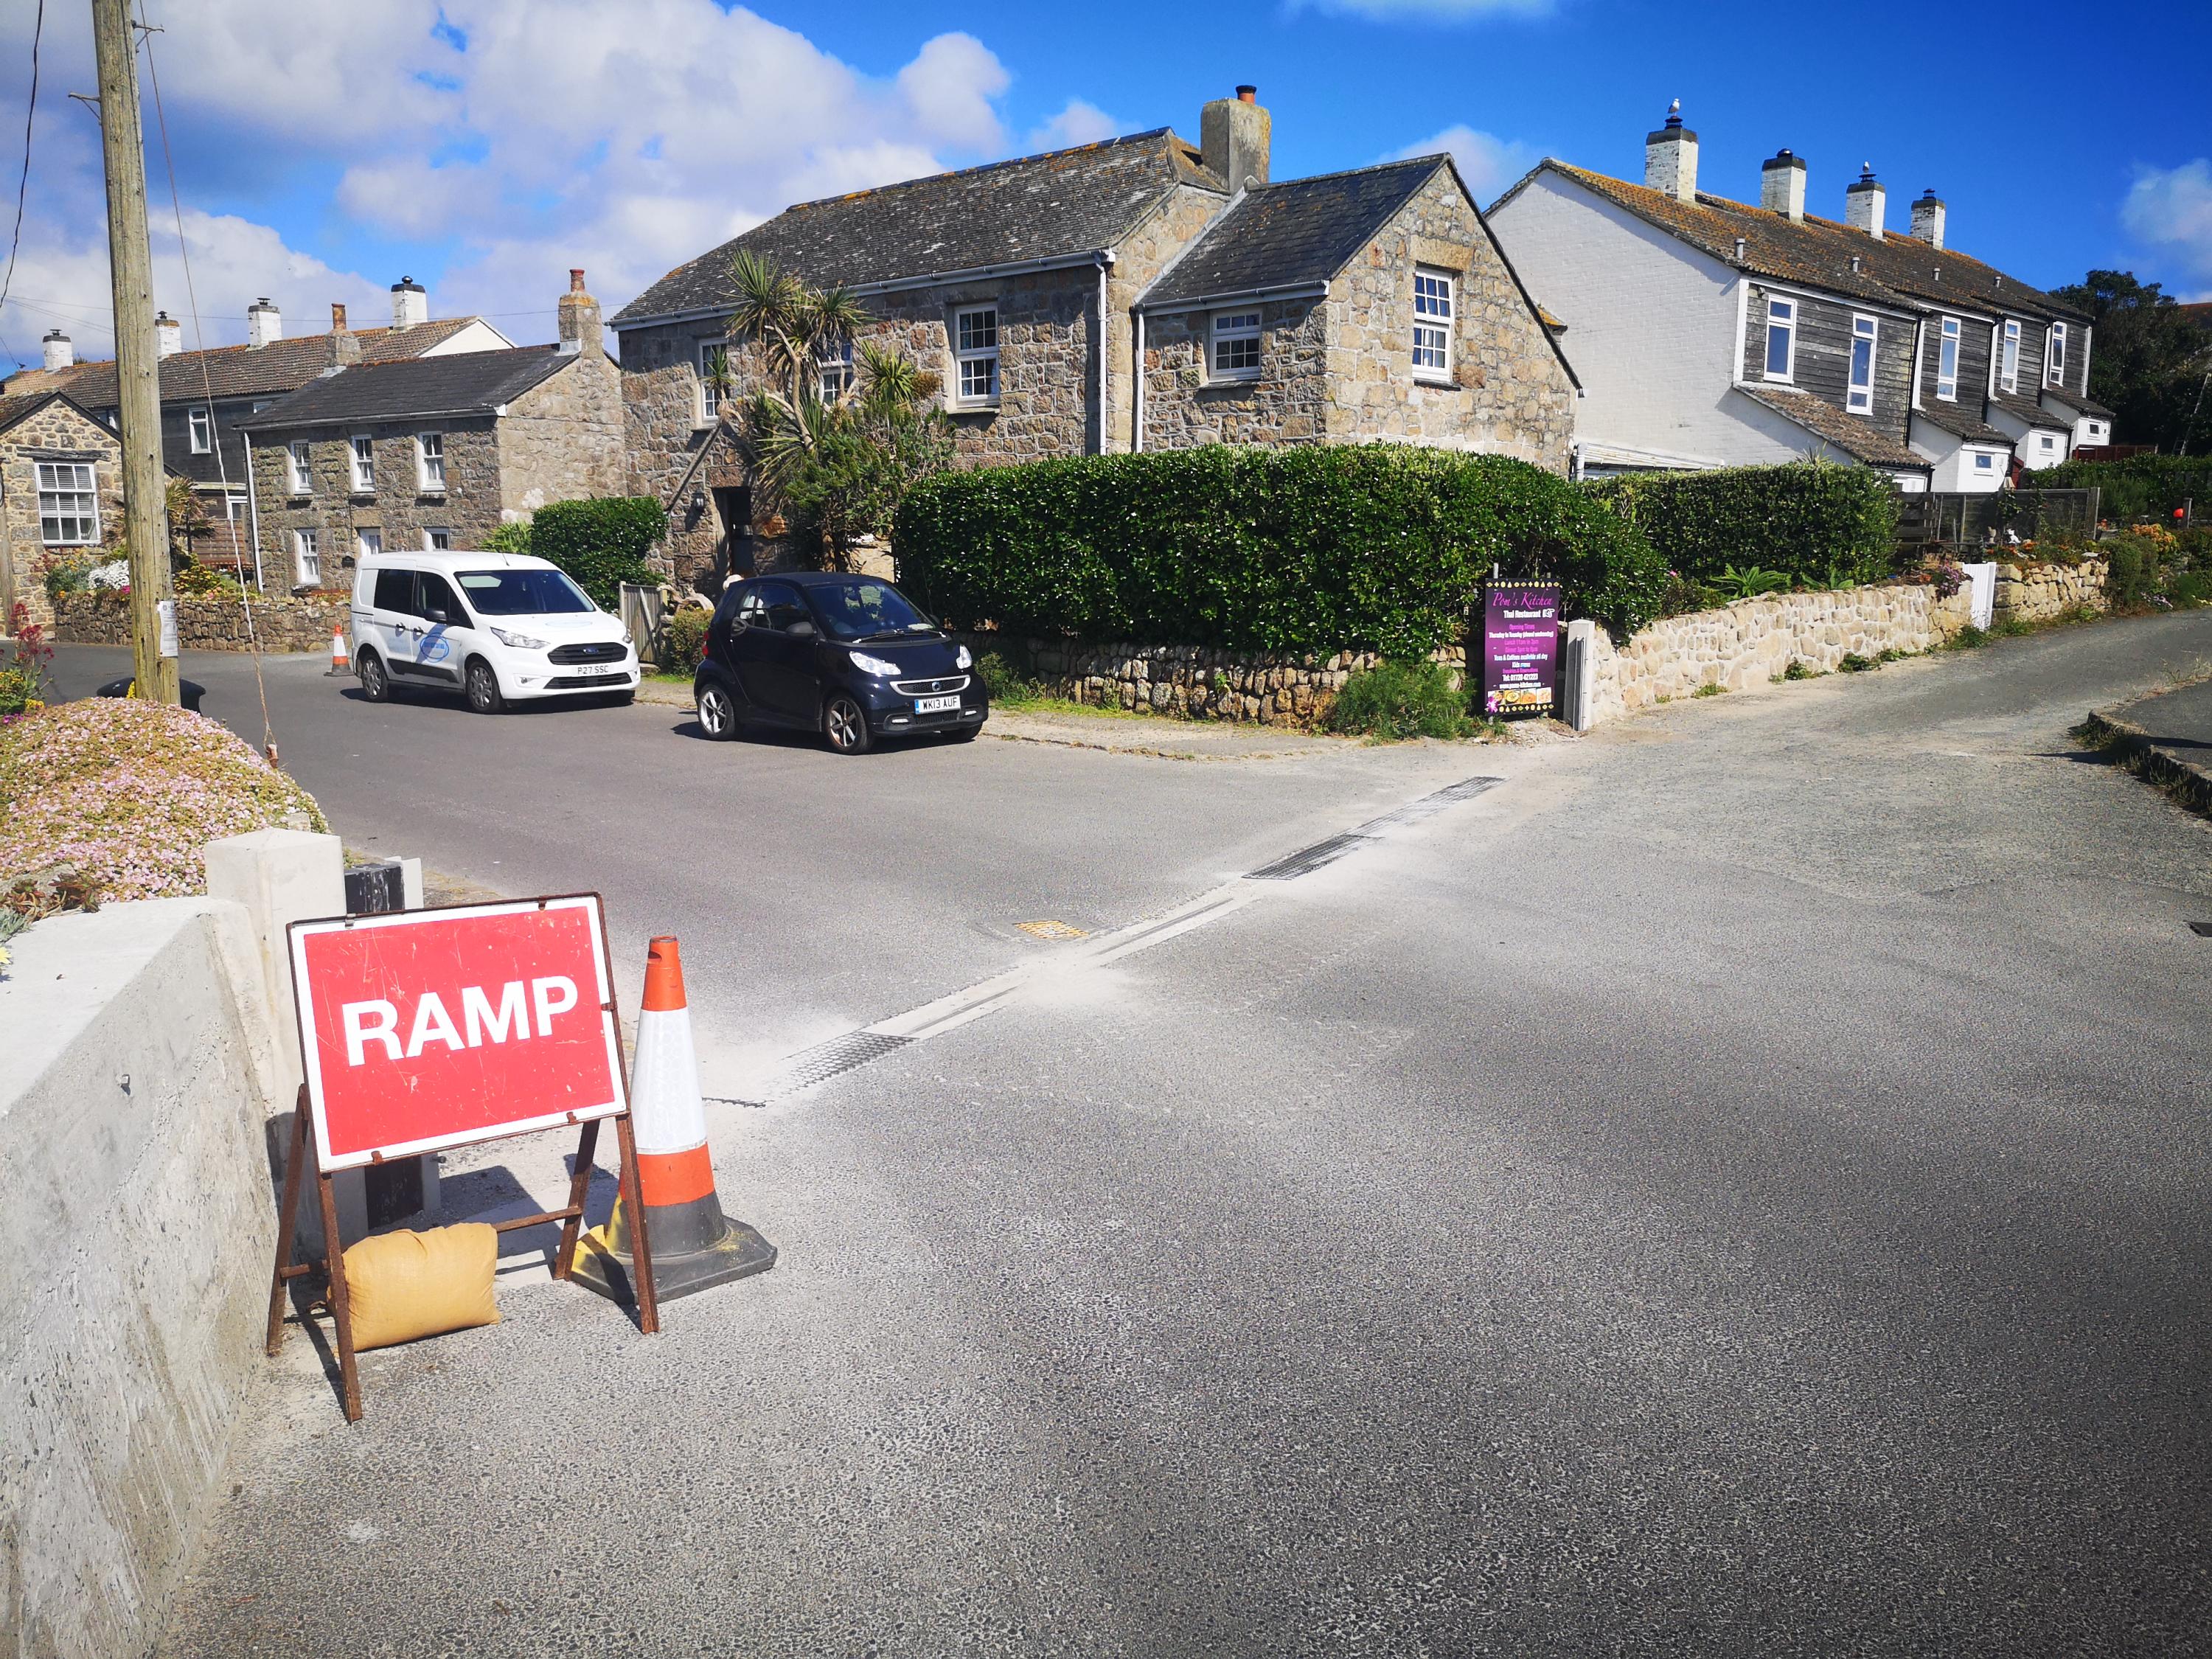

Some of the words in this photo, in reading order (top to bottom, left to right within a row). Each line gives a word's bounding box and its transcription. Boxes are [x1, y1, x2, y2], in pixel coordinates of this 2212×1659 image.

[1493, 592, 1517, 606] Pom's
[1521, 590, 1552, 609] Kitchen
[1514, 610, 1541, 618] Restaurant
[578, 667, 593, 675] P27
[595, 665, 608, 673] SSC
[943, 698, 957, 708] AUF
[341, 975, 579, 1067] RAMP
